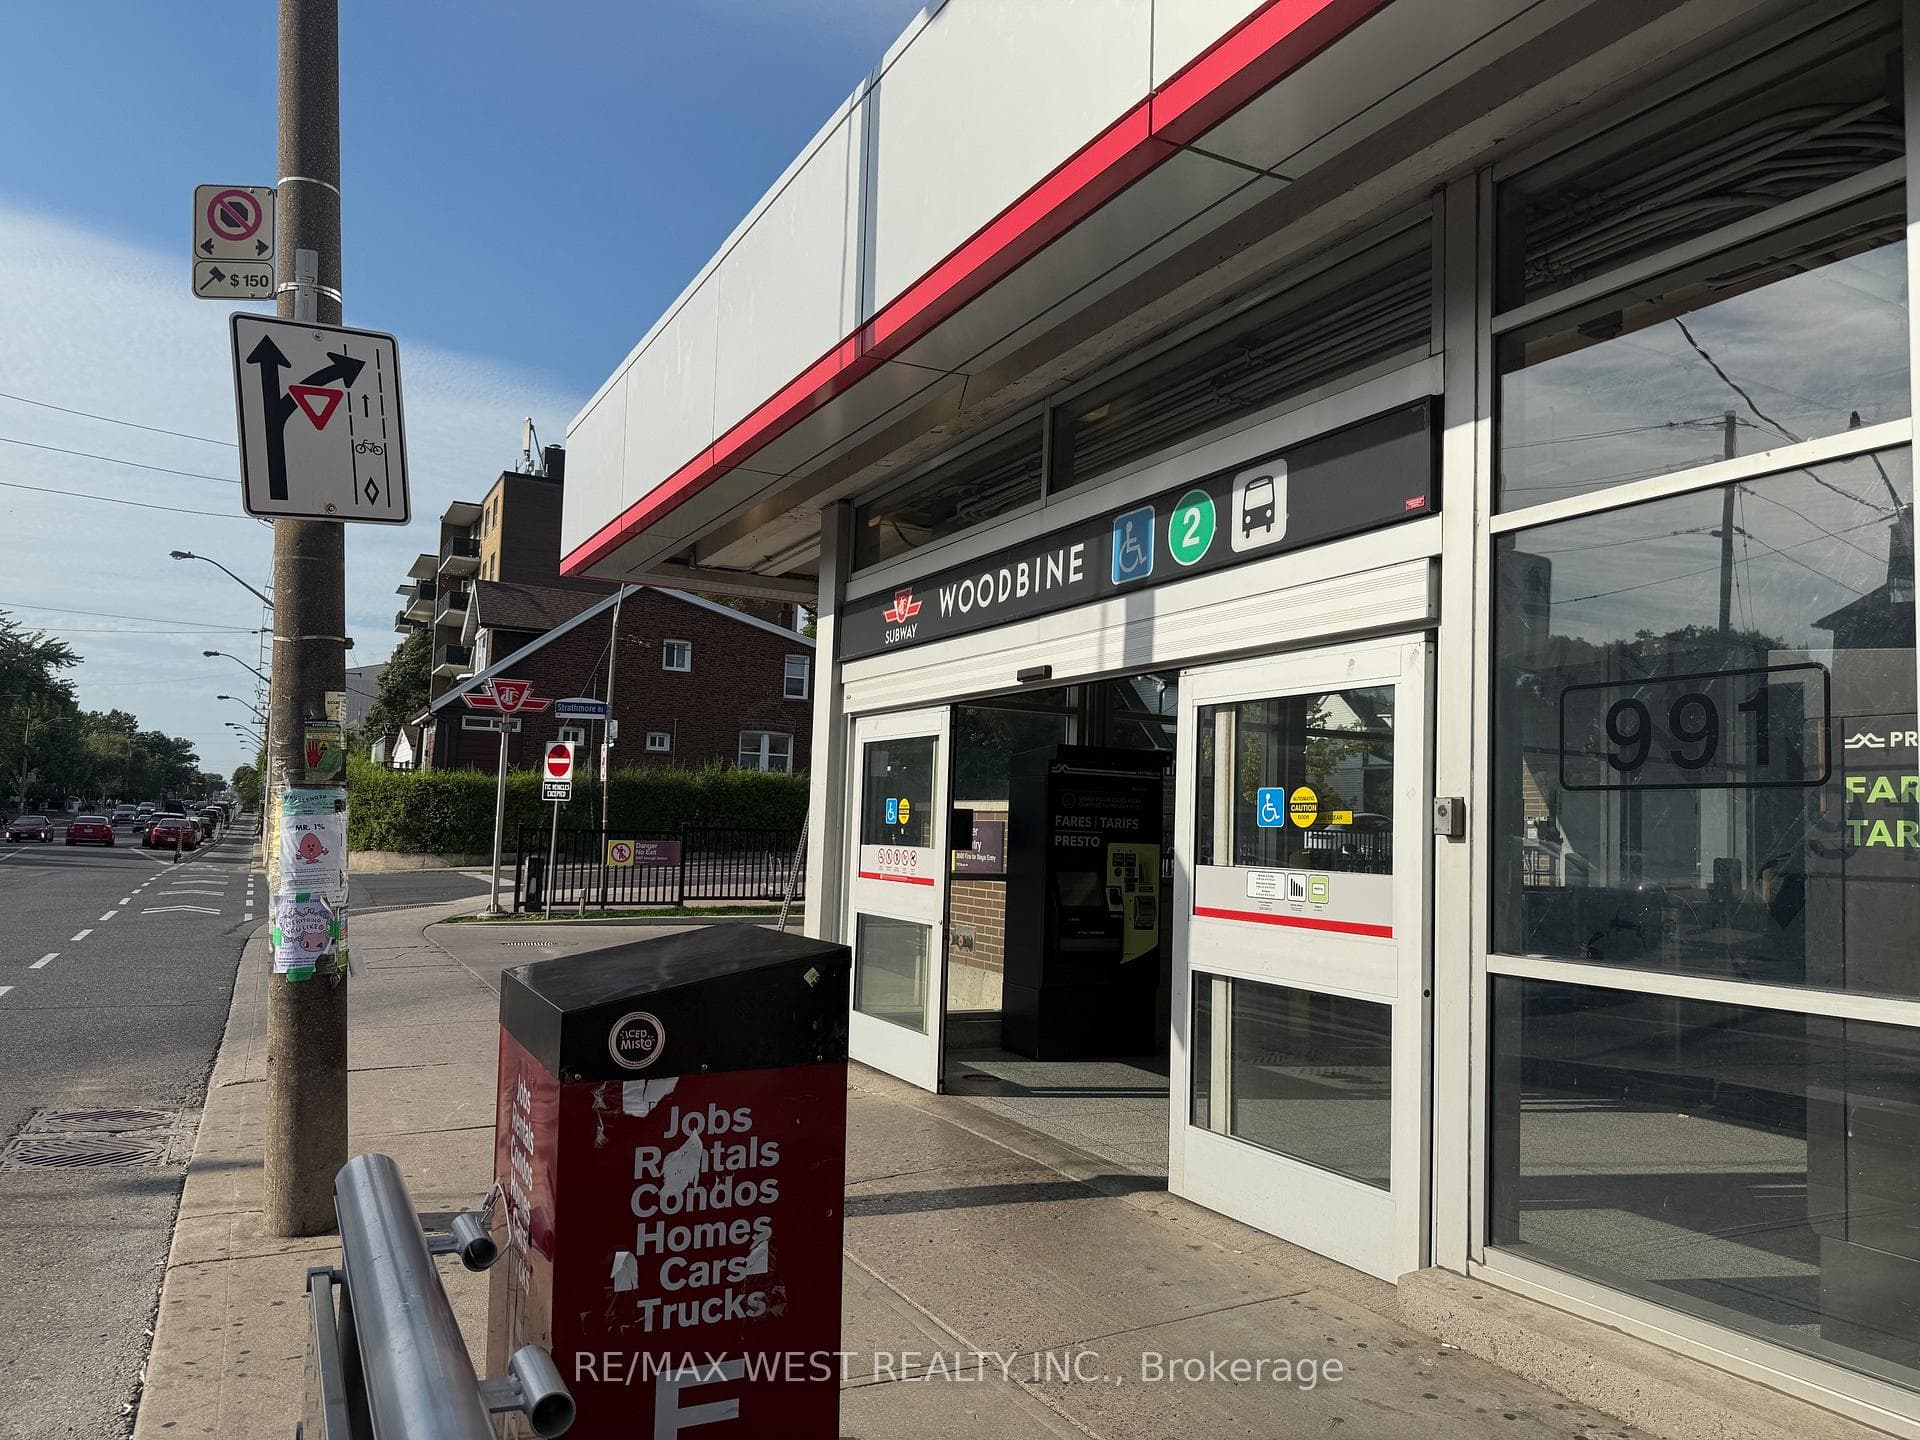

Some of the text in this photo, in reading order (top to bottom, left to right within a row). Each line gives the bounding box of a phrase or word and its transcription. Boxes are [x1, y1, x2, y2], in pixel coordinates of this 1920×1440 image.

[230, 274, 269, 288] $ 150
[1182, 508, 1202, 548] 2
[938, 542, 1084, 618] WOODBINE
[884, 623, 918, 644] SUBWAY
[557, 703, 597, 713] Strathmore
[1605, 687, 1771, 772] 991
[1055, 815, 1139, 830] FARES TARIFS
[1290, 804, 1317, 812] CAUTION
[635, 842, 658, 851] Danger
[1055, 835, 1101, 847] PRESTO
[285, 926, 301, 935] YOU
[625, 1029, 648, 1039] ICED
[516, 1072, 531, 1114] Jobs
[511, 1100, 534, 1156] Rentals
[663, 1103, 753, 1139] Jobs
[511, 1134, 533, 1192] Condos
[630, 1175, 780, 1218] Condos
[636, 1214, 773, 1257] Homes
[659, 1254, 748, 1292] Cars
[636, 1289, 768, 1333] Trucks
